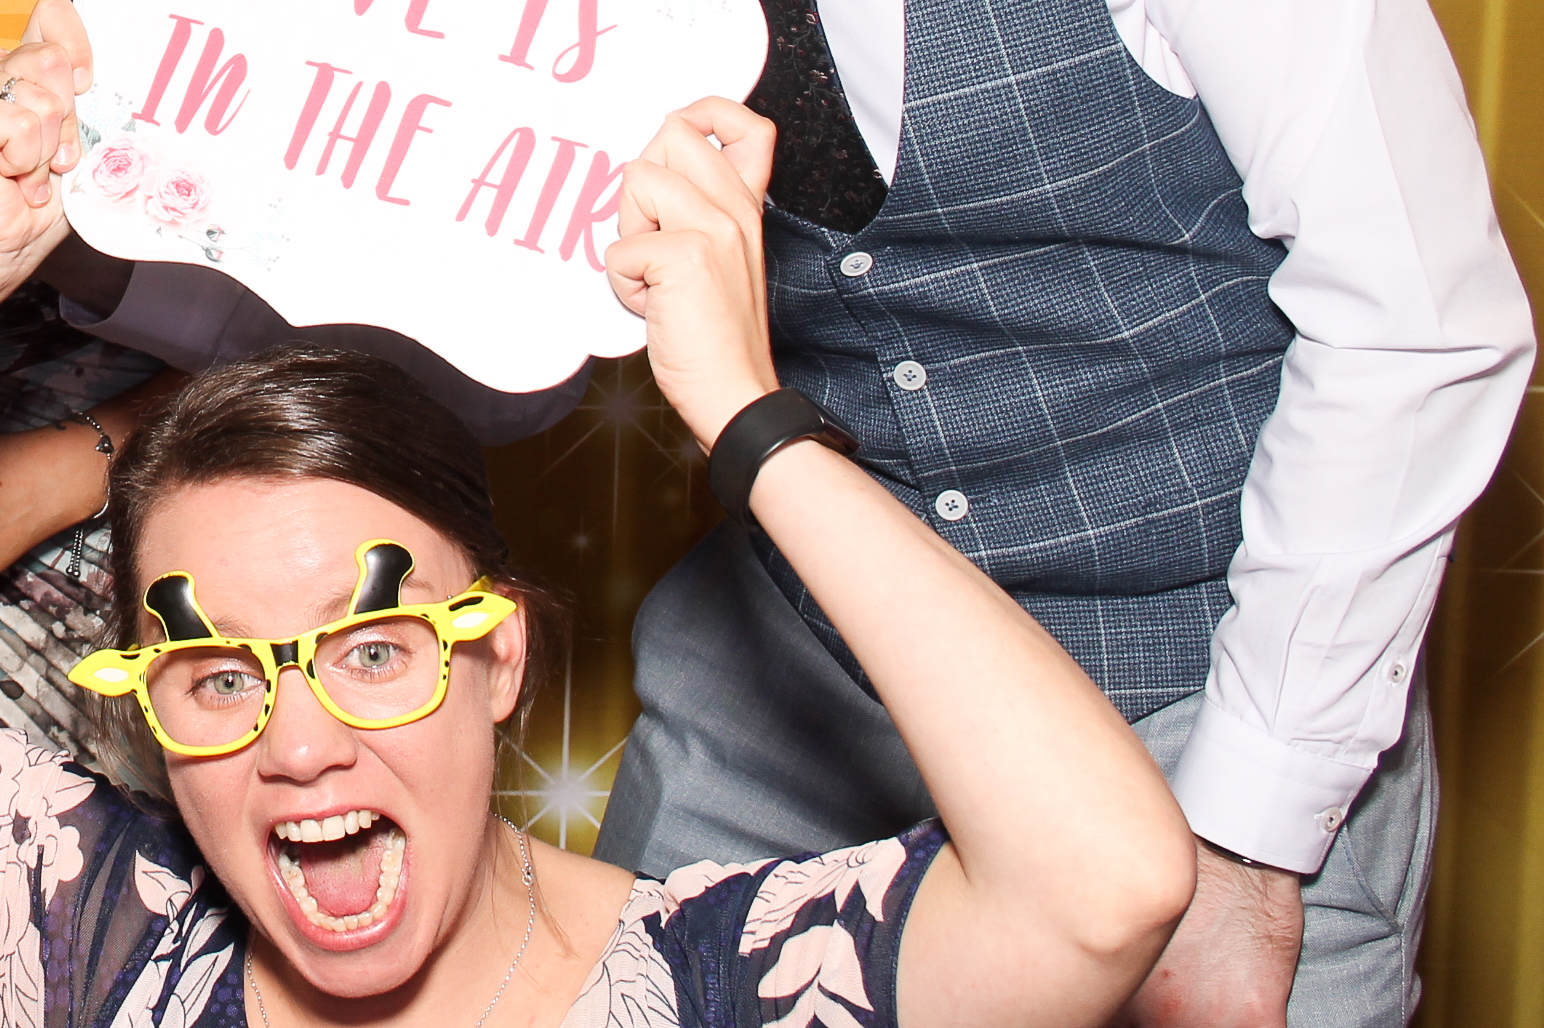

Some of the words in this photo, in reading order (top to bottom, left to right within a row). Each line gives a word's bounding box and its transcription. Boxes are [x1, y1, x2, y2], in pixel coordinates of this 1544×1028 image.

[131, 13, 251, 138] IN
[282, 60, 454, 207] THE
[455, 126, 628, 274] AIR
